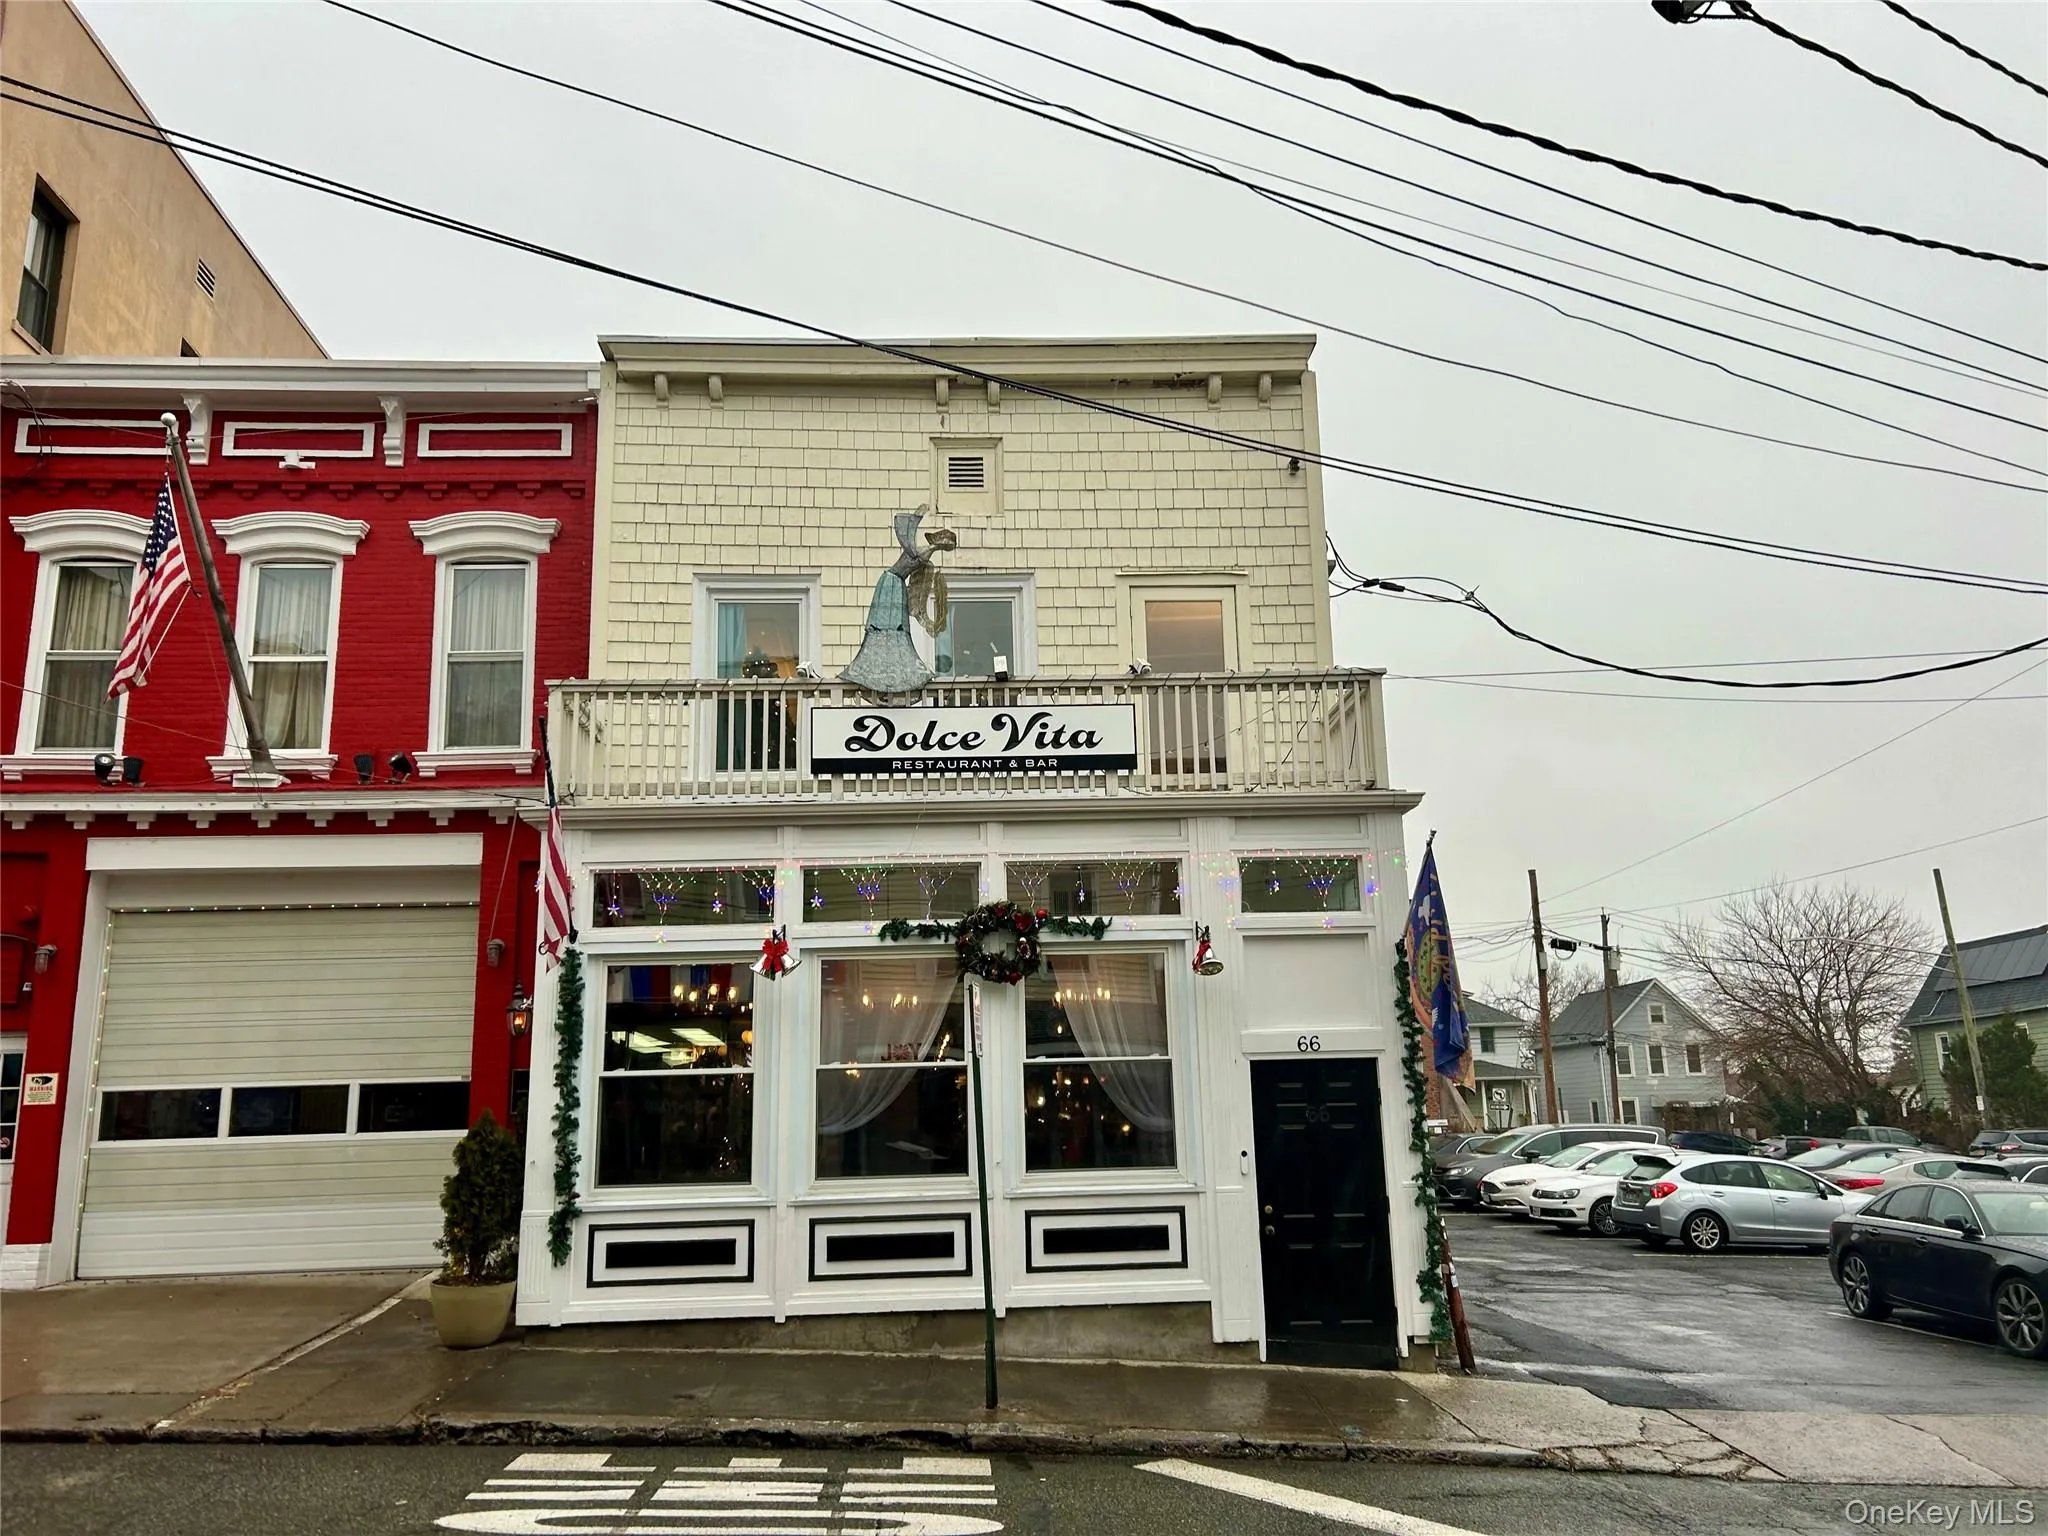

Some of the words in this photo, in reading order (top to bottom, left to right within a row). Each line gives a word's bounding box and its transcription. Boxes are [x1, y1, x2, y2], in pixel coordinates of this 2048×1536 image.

[844, 714, 986, 752] Dolce
[990, 711, 1104, 752] Vita
[892, 759, 1003, 770] RESTAURANT
[1008, 759, 1018, 768] &
[1025, 758, 1058, 768] BAR
[1297, 1035, 1321, 1052] 66
